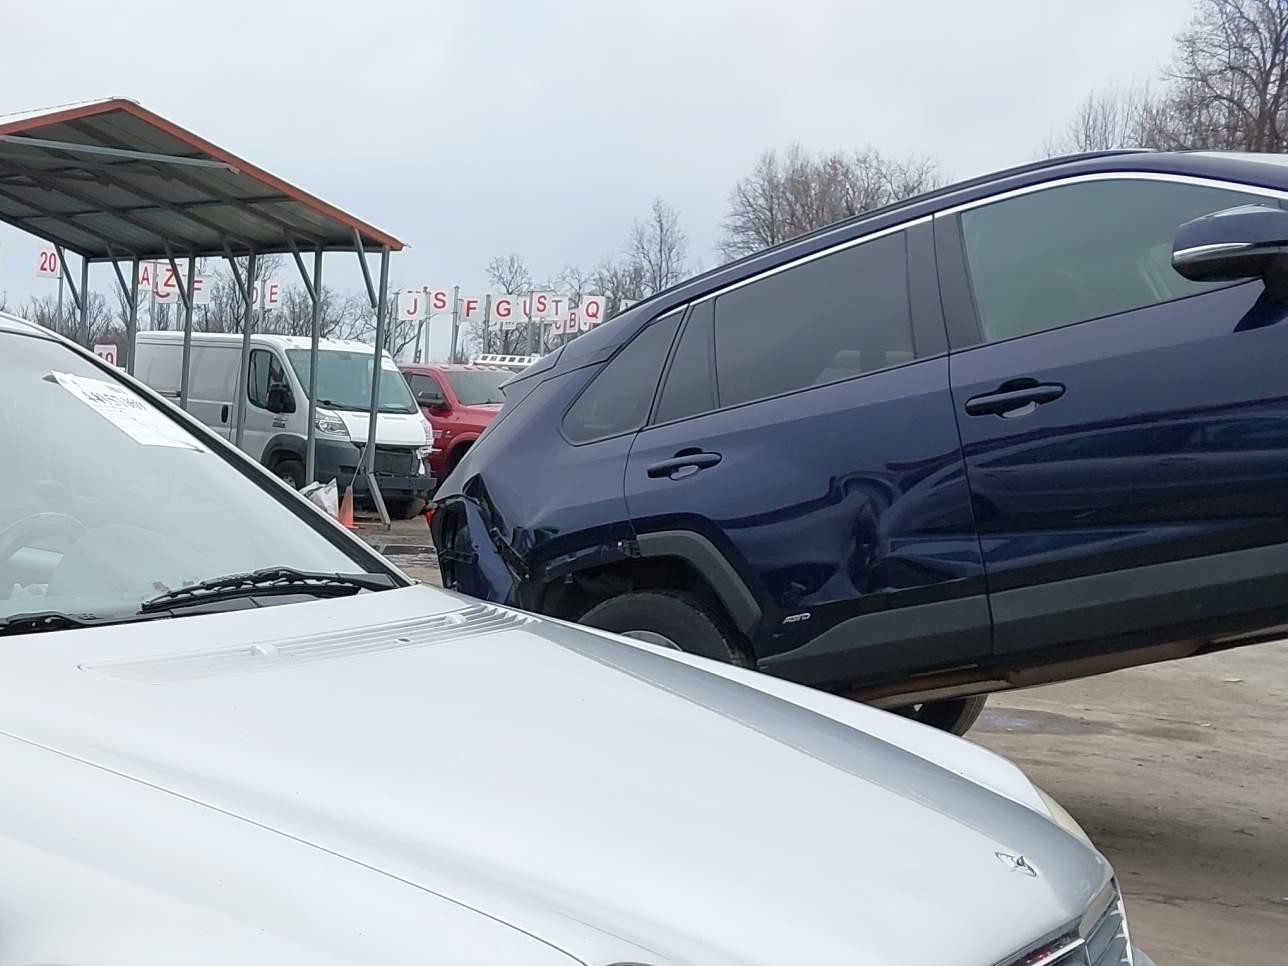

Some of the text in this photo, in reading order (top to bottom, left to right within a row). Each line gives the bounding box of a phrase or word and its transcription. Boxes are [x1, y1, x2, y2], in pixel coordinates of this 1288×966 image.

[40, 252, 57, 272] 20
[270, 285, 279, 303] E
[434, 292, 447, 309] S
[407, 298, 418, 315] J
[466, 301, 478, 317] F
[496, 300, 511, 317] G
[537, 295, 546, 312] S
[552, 300, 562, 315] T
[585, 301, 599, 319] Q
[569, 312, 577, 328] B
